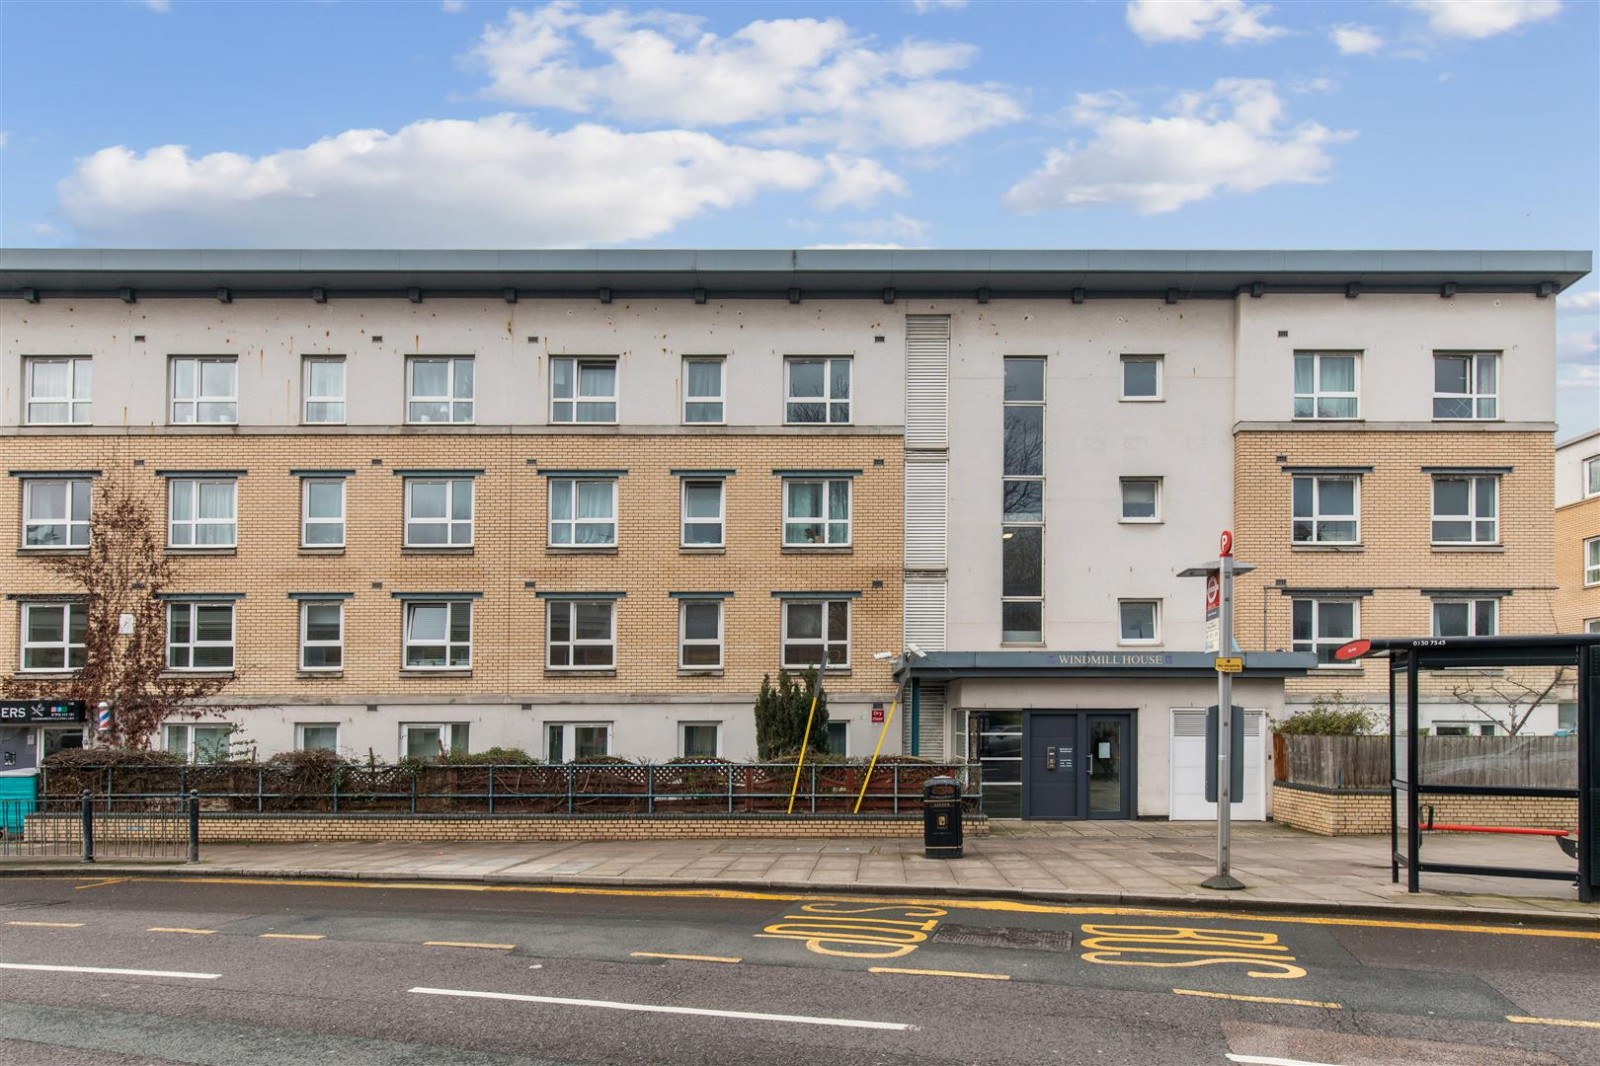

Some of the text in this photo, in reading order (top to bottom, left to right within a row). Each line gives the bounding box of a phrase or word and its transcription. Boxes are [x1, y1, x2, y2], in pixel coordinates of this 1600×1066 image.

[1059, 655, 1163, 664] WINDMILL HOUSE
[1081, 924, 1307, 979] BUS
